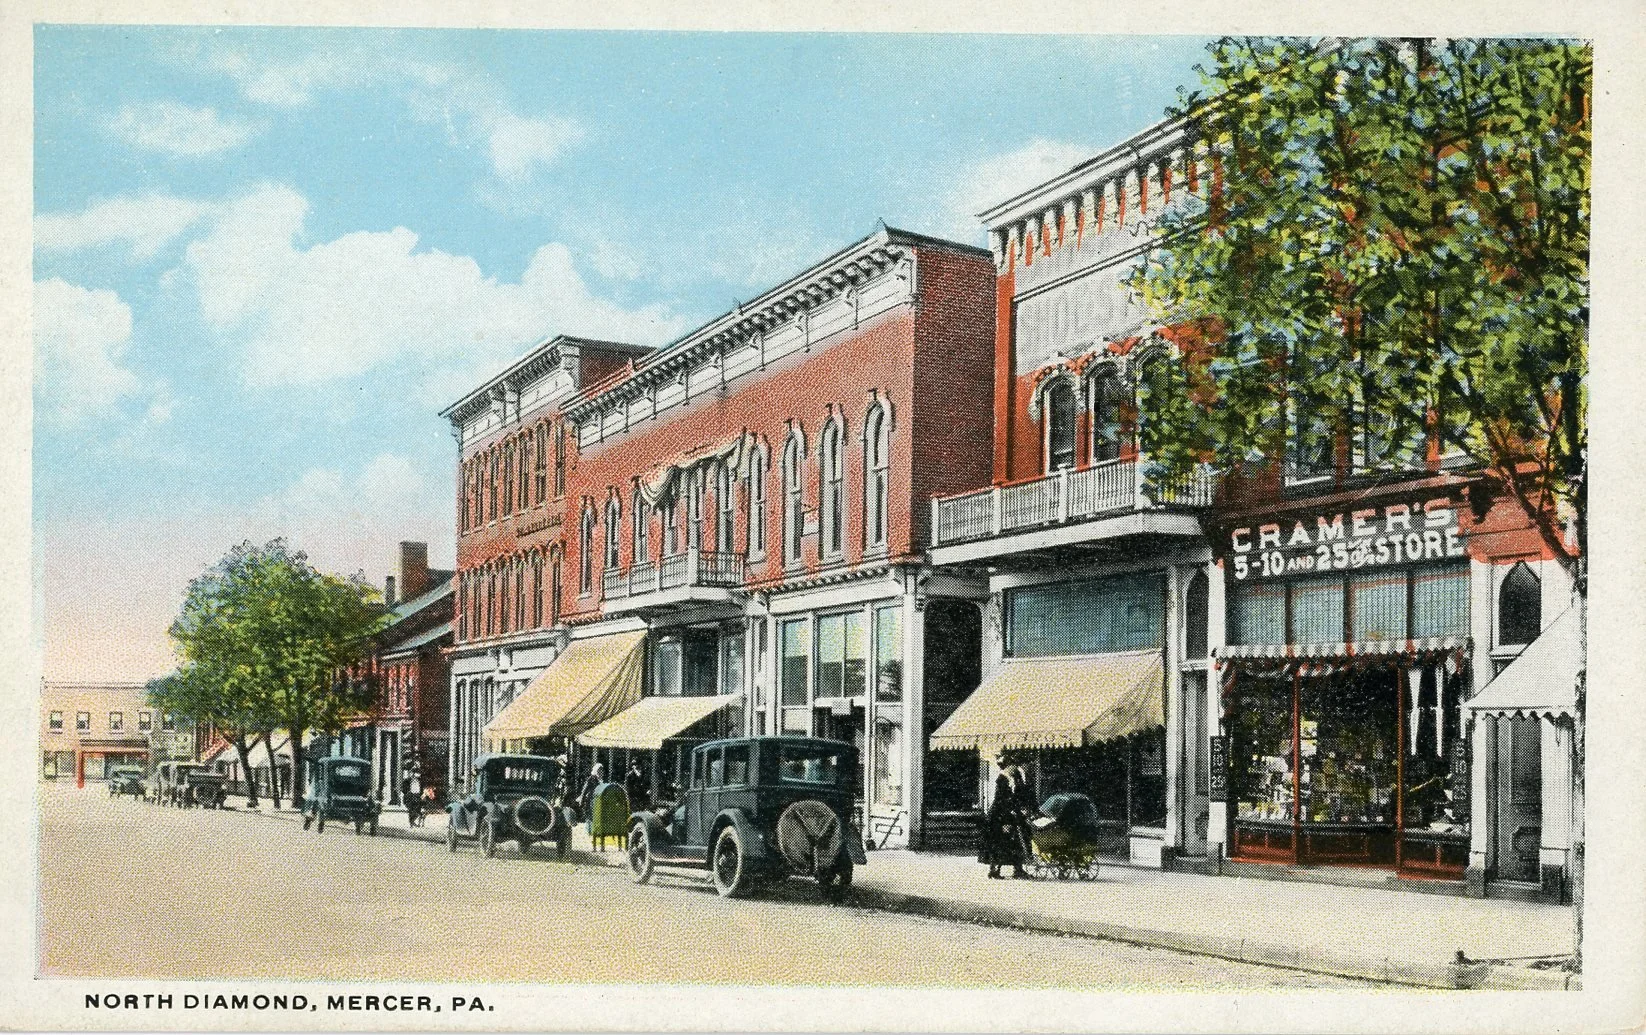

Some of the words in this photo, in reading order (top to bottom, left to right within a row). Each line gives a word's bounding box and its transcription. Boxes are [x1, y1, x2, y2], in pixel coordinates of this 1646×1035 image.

[1231, 497, 1451, 553] CRAMER'S
[1233, 551, 1285, 580] 5-10
[1287, 554, 1314, 571] AND
[1375, 527, 1464, 564] STORE
